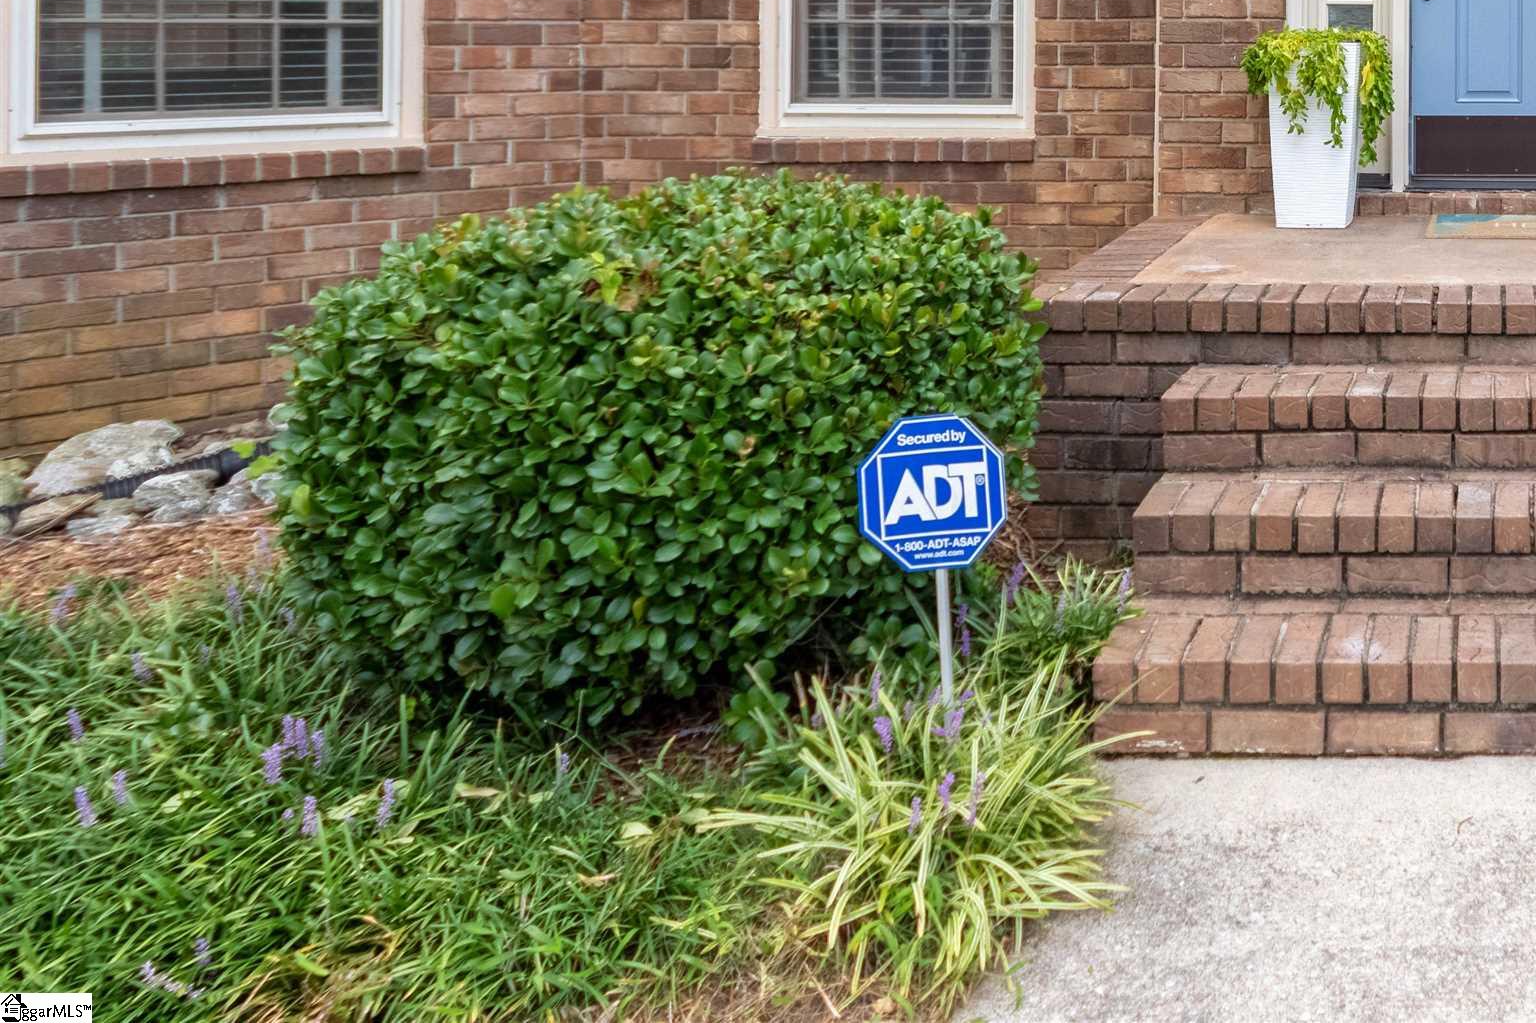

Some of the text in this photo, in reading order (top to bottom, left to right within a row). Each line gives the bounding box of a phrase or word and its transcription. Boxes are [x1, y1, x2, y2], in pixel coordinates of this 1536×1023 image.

[897, 429, 965, 446] Secured by
[895, 537, 981, 552] 1-800-ADT-ASAP
[914, 550, 964, 559] www.adt.com
